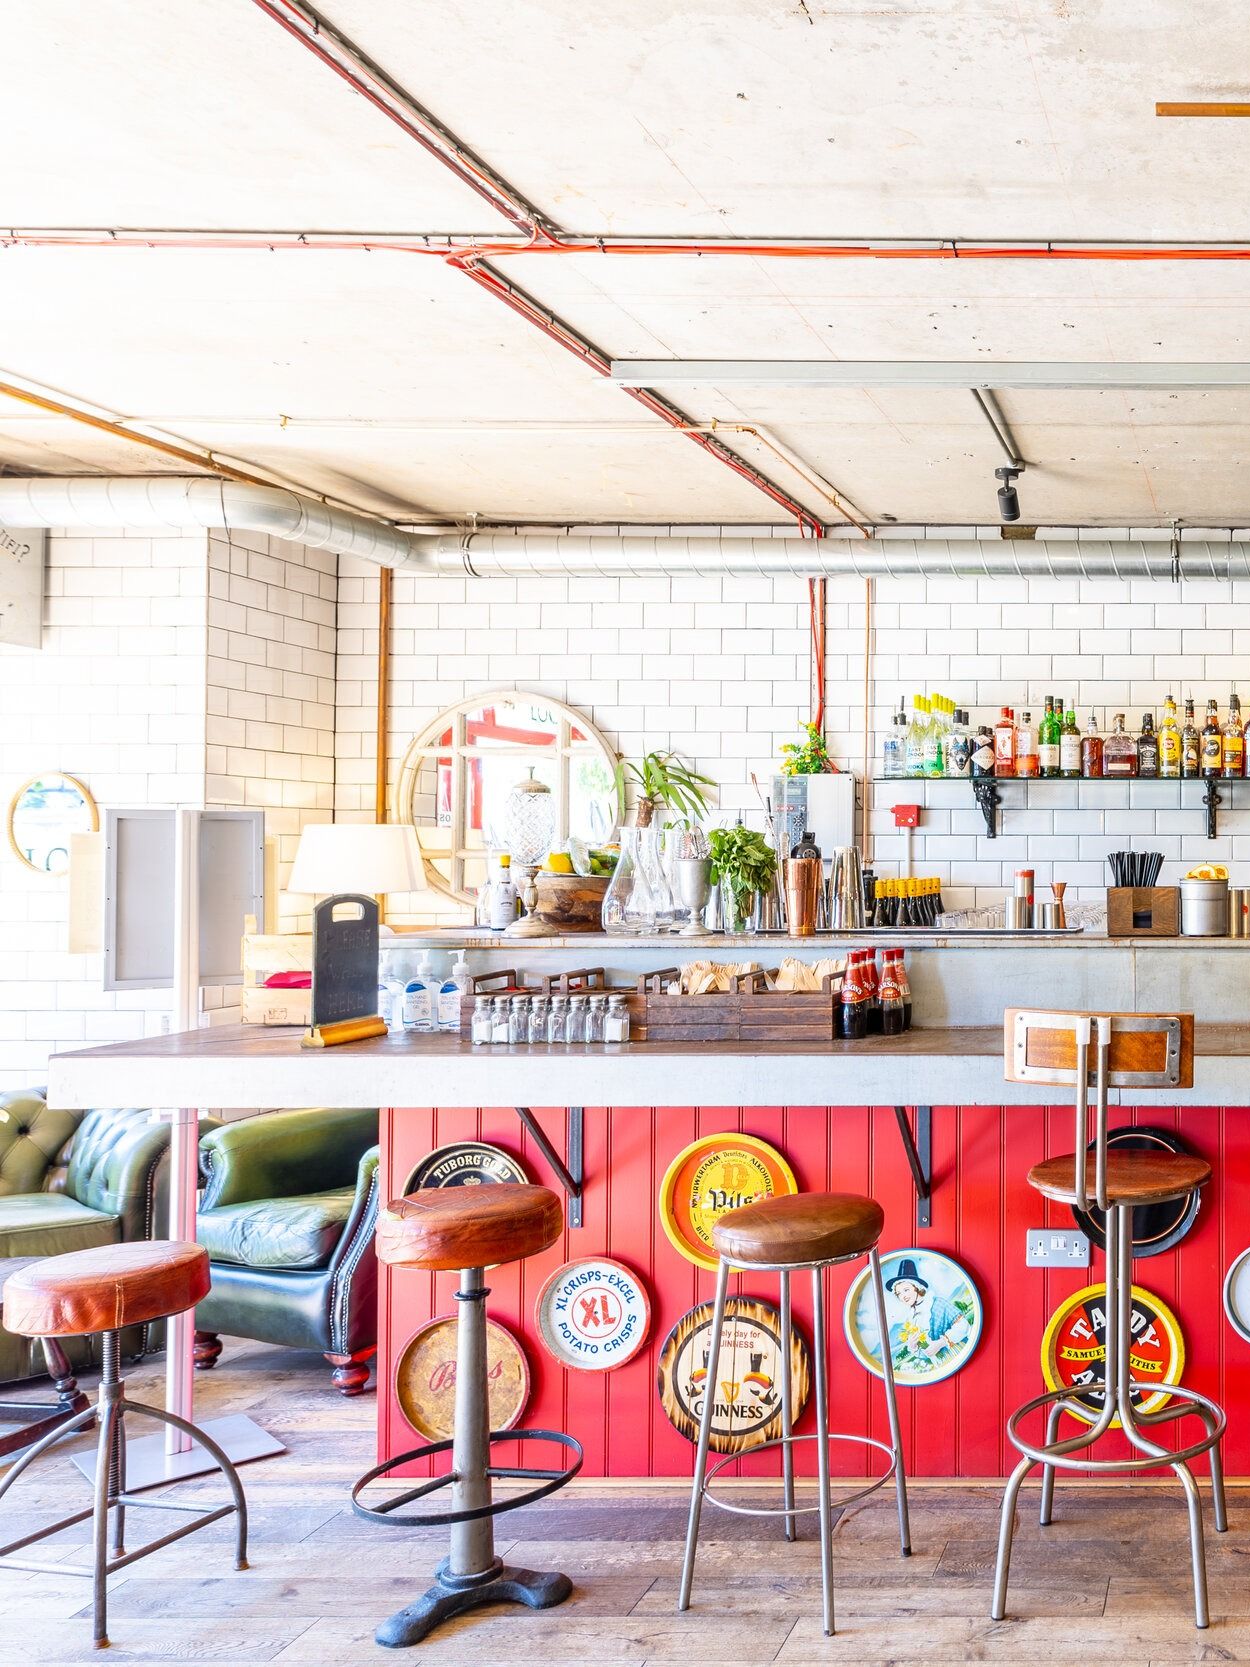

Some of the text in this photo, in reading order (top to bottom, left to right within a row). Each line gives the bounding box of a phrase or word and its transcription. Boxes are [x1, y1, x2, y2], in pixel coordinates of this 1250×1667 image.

[433, 1155, 512, 1180] TUBORG GOLD
[555, 1297, 569, 1311] XL
[579, 1295, 617, 1328] XL
[558, 1314, 637, 1354] POTATO CRISPS
[707, 1328, 761, 1339] Lely day for
[1069, 1307, 1160, 1348] TADY
[716, 1340, 754, 1349] UINNESS
